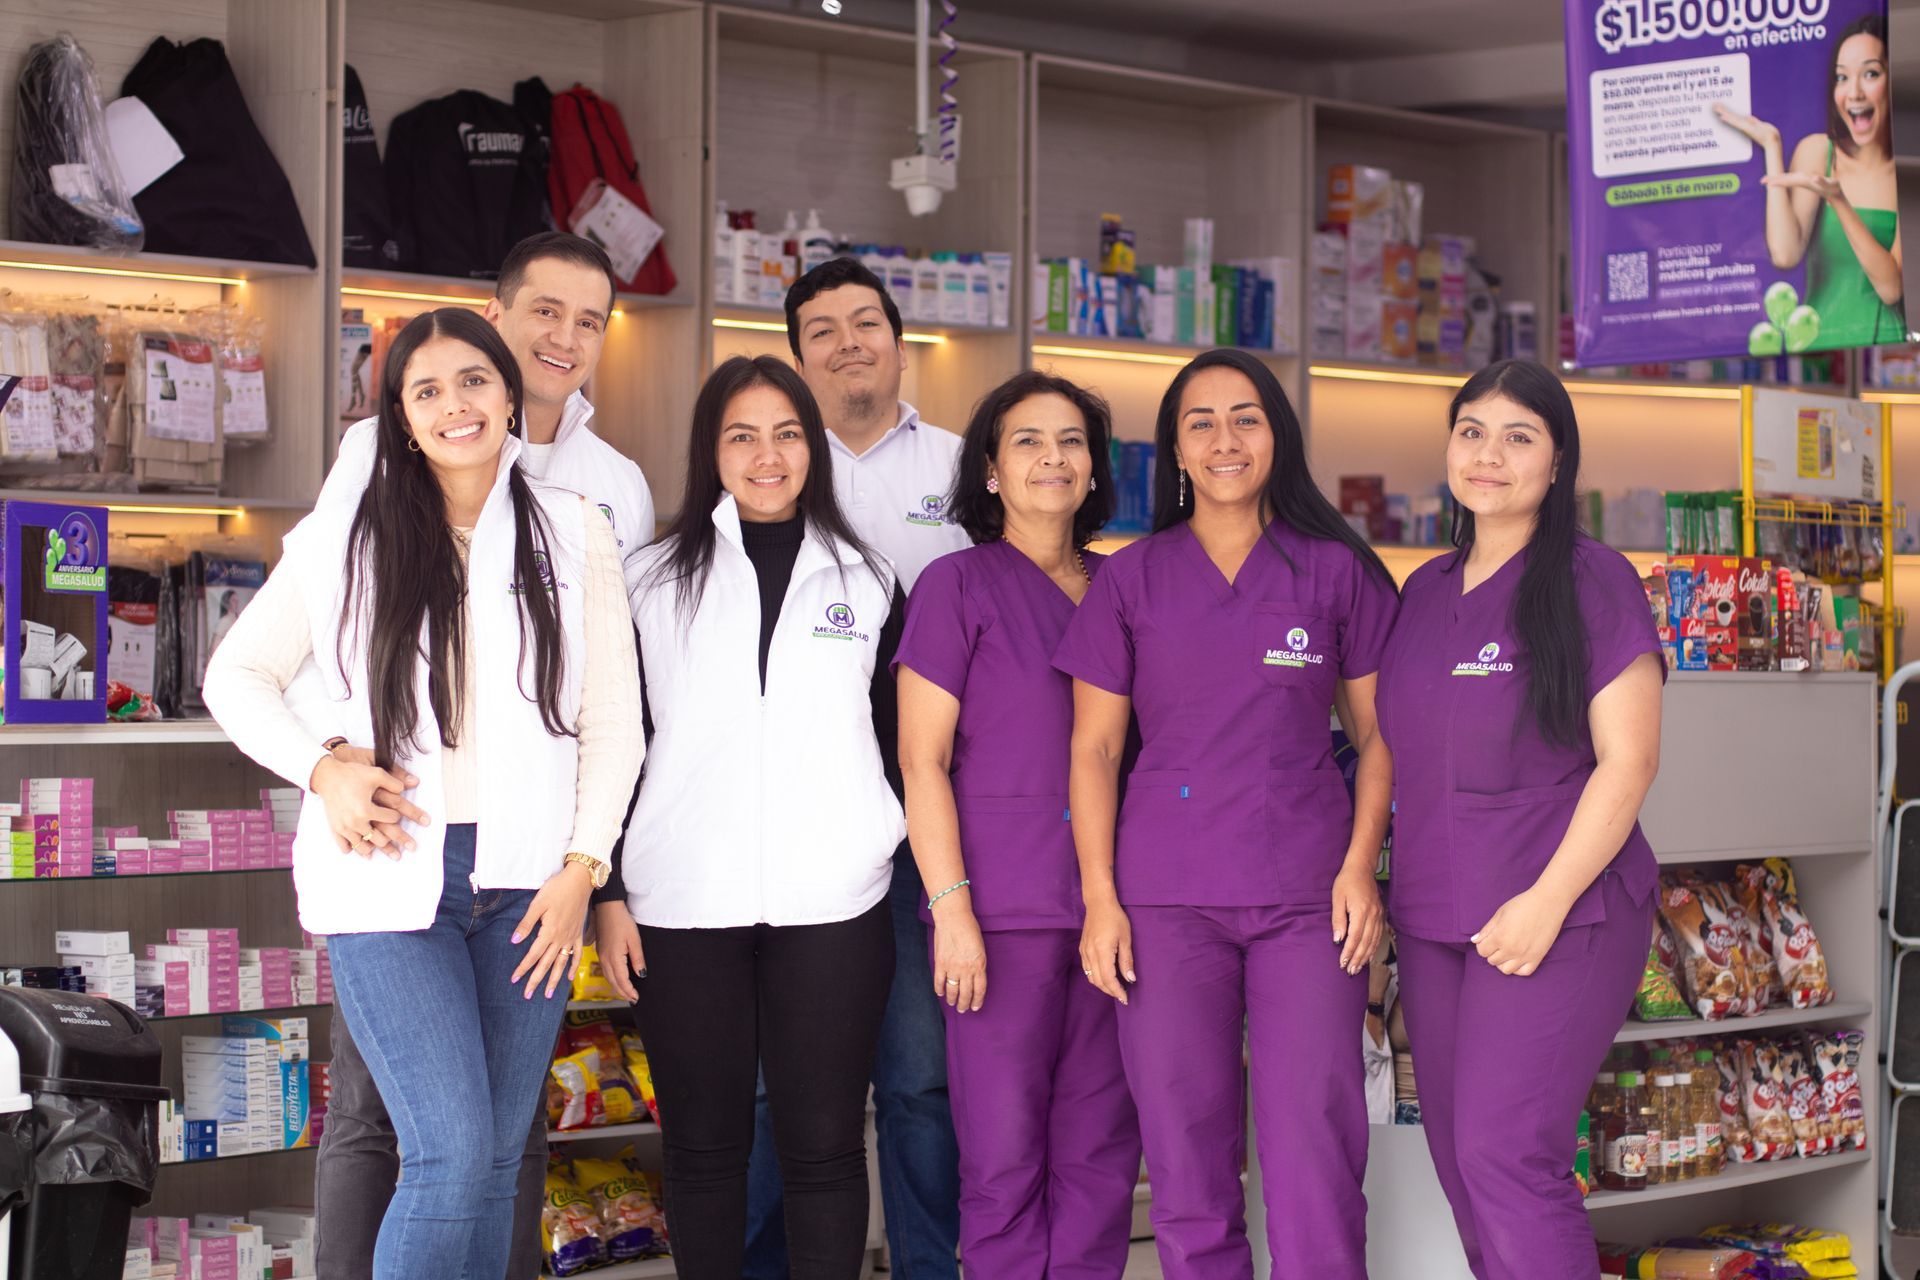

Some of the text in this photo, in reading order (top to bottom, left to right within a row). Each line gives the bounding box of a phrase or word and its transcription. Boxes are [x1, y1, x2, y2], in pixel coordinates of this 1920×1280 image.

[1724, 23, 1827, 50] en efectivo
[1602, 78, 1618, 87] Por
[1620, 73, 1664, 85] compras
[1666, 67, 1711, 80] mayores
[1644, 84, 1670, 94] entre
[1672, 82, 1681, 91] el
[1697, 78, 1707, 88] el
[1709, 76, 1718, 86] 15
[1721, 75, 1734, 85] de
[1661, 183, 1673, 195] 15
[1675, 182, 1691, 194] de
[1693, 179, 1733, 192] marzo
[1705, 243, 1722, 257] por
[1658, 255, 1711, 270] consultas
[1706, 262, 1756, 281] gratuitas
[67, 520, 89, 567] 3
[58, 565, 95, 574] ANIVERSARIO
[52, 574, 104, 587] MEGASALUD
[814, 626, 869, 642] MEGASALUD
[1266, 649, 1323, 664] MEGASALUD
[1455, 662, 1513, 672] MEGASALUD
[73, 1011, 88, 1019] NO
[286, 1073, 300, 1131] BEDOYECTA
